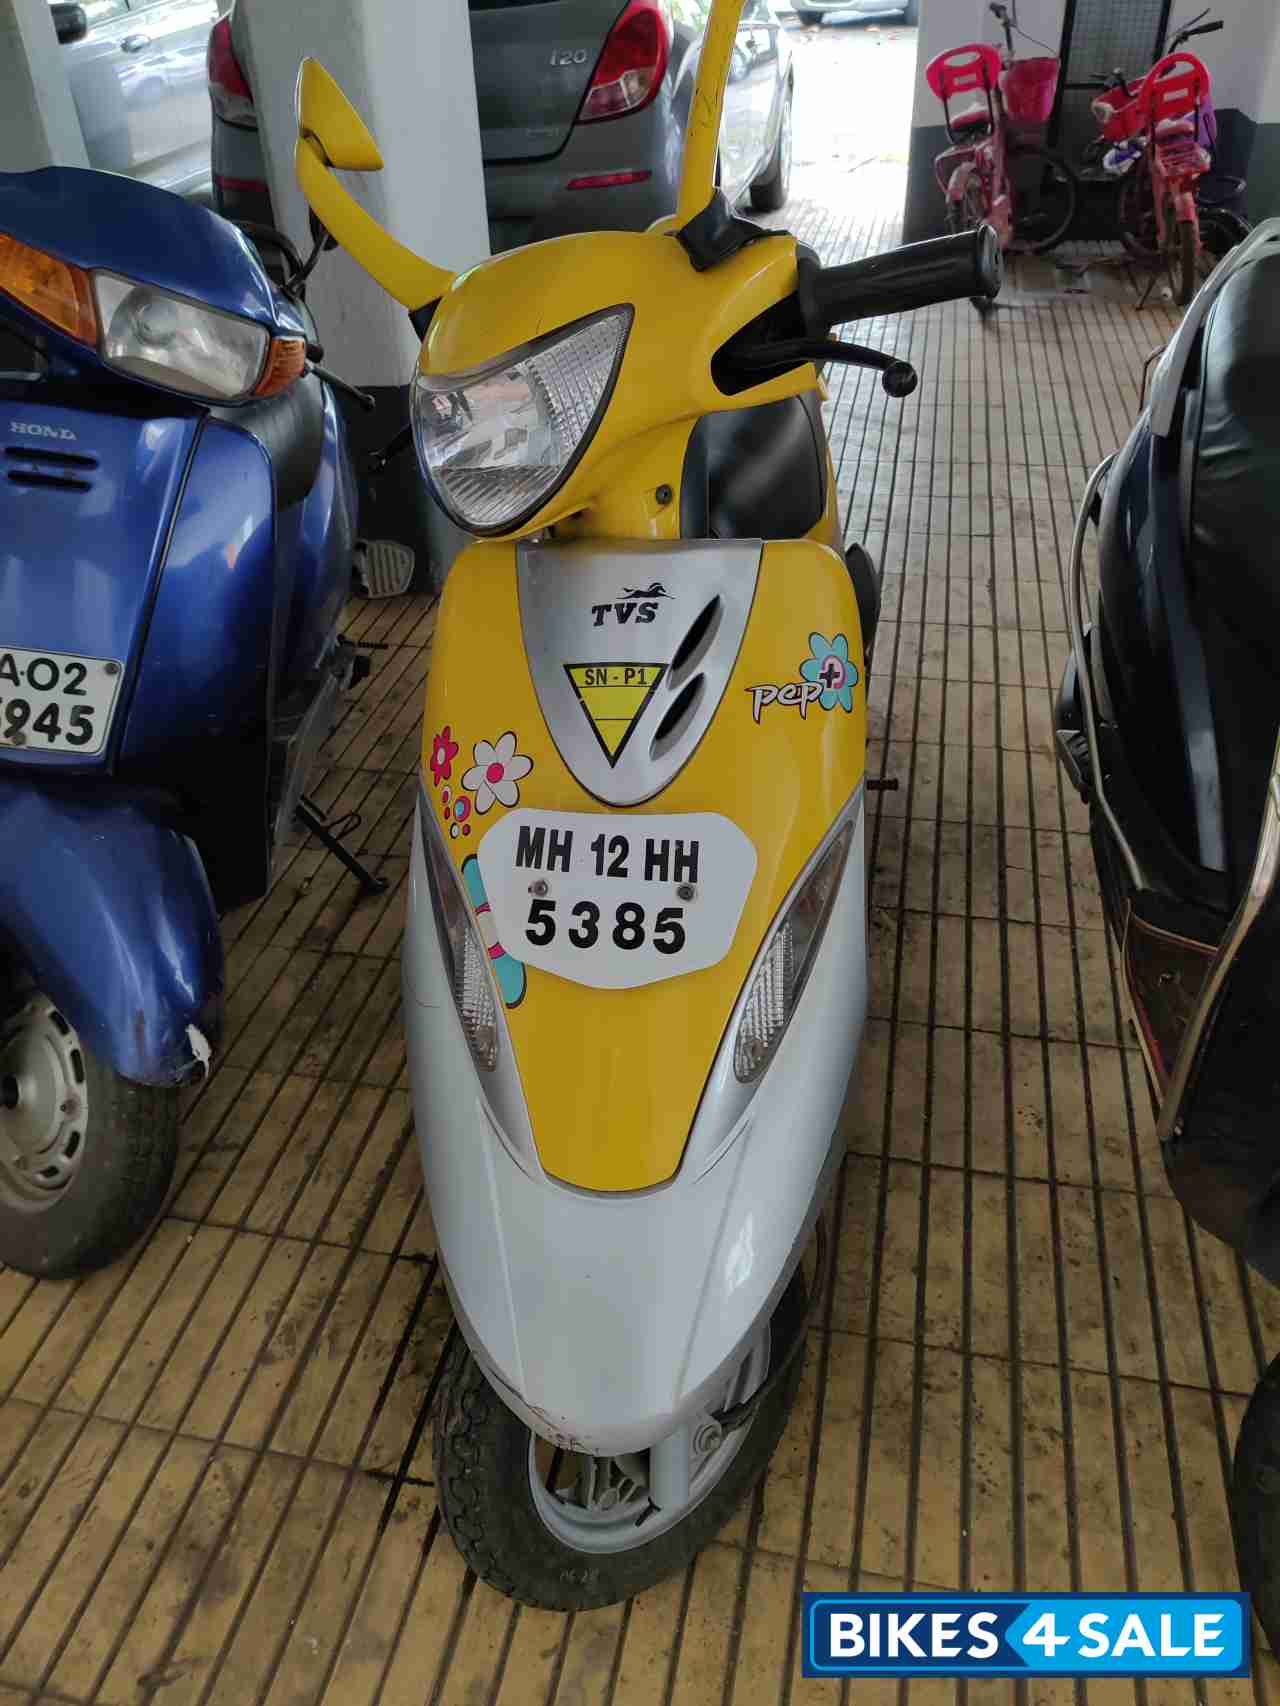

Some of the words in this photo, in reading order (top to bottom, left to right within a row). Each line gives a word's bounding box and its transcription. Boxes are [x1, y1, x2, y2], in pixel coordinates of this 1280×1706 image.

[592, 602, 659, 627] TVS
[0, 698, 95, 746] 945
[515, 825, 573, 872] MH
[591, 833, 629, 878] 12
[644, 838, 699, 883] HH
[525, 898, 686, 955] 5385
